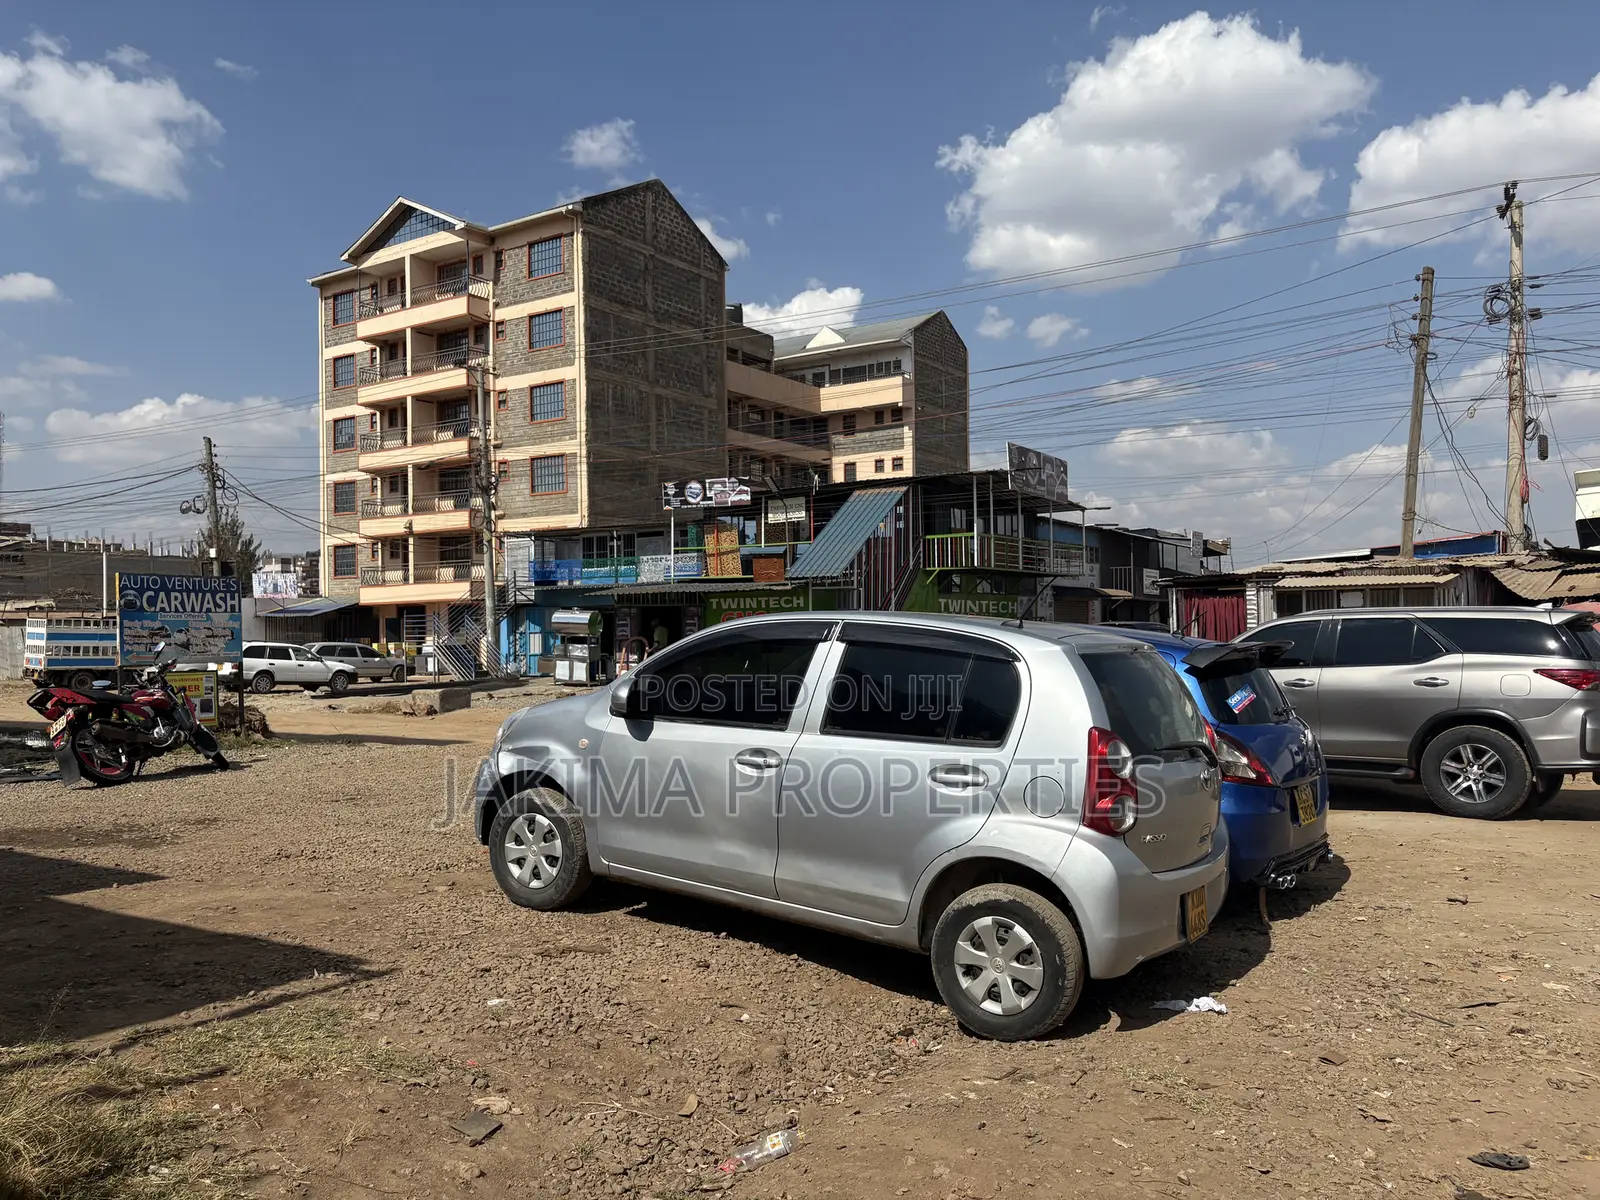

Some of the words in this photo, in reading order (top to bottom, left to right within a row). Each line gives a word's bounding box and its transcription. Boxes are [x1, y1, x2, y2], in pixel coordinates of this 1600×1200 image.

[120, 575, 160, 589] AUTO
[165, 576, 237, 590] VENTURE'S
[142, 590, 239, 612] CARWASH
[710, 596, 805, 610] TWINTECH
[938, 598, 1017, 614] TWINTECH
